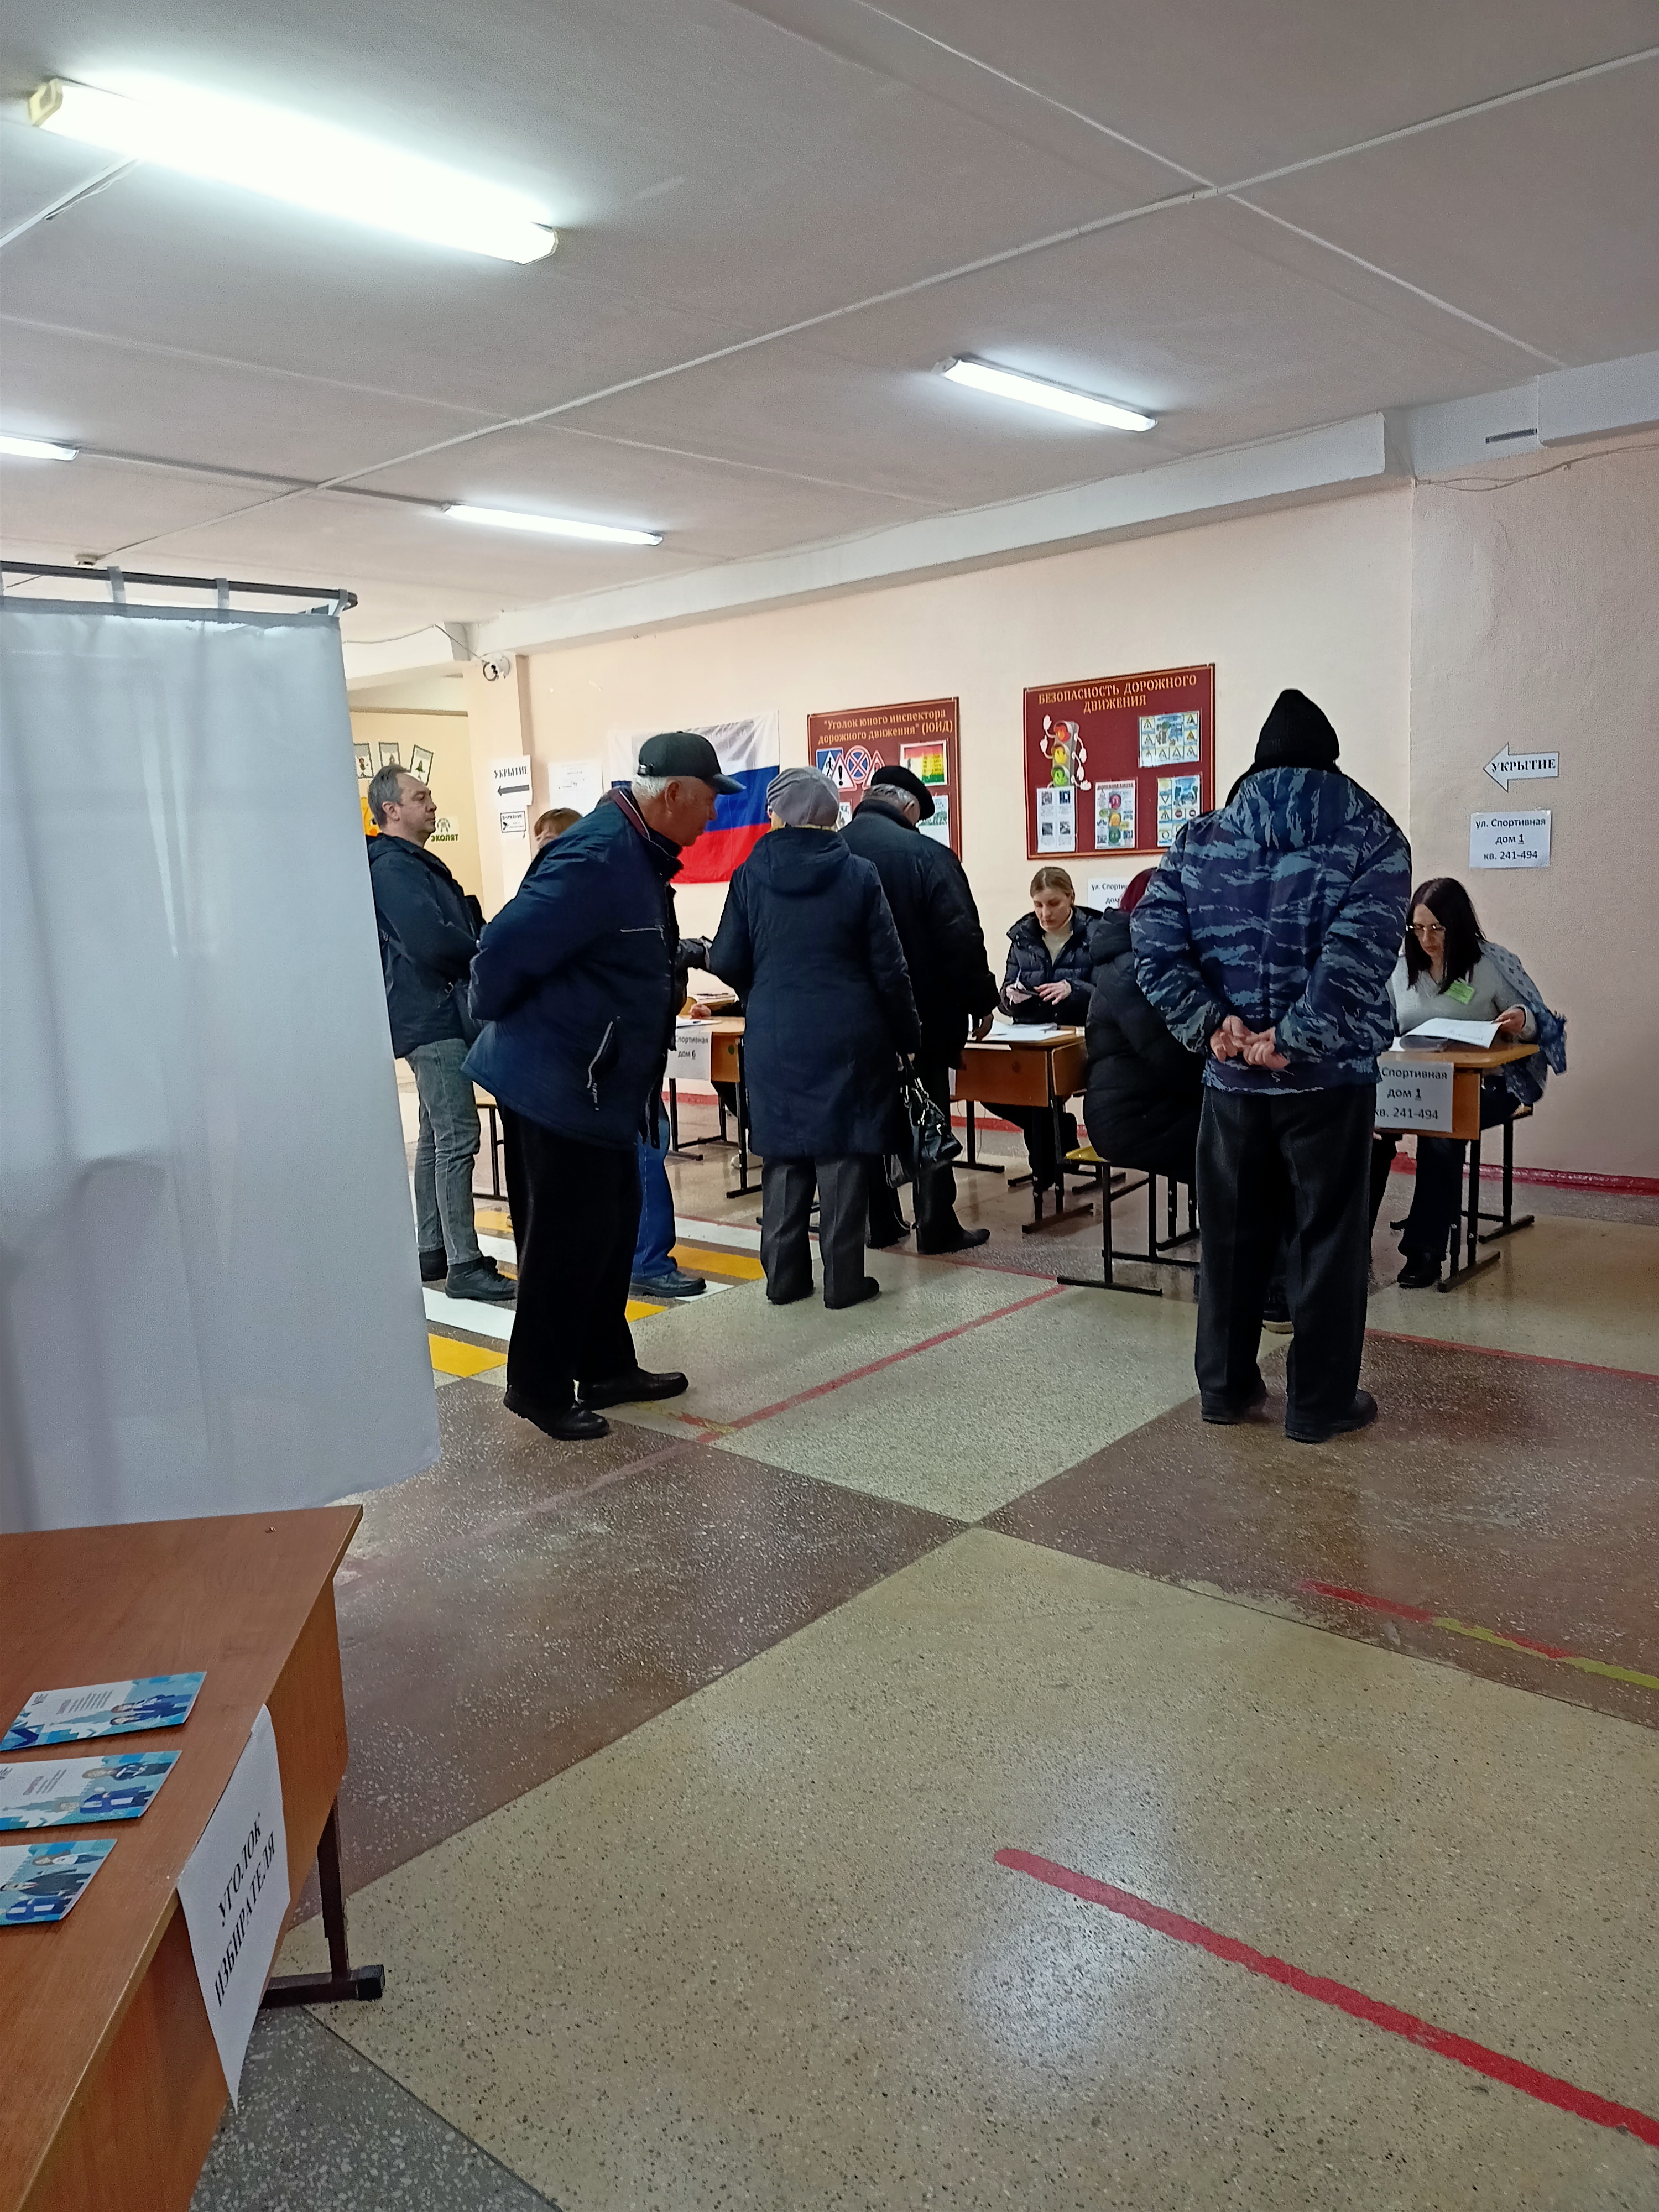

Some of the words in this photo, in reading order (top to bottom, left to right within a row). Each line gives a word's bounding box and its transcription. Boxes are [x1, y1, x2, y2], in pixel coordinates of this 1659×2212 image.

[1038, 684, 1120, 705] БЕЗОПАСНОСТЬ
[1124, 674, 1197, 696] ДОРОЖНОГО
[1083, 694, 1147, 714] ДВИЖЕНИЯ
[824, 719, 858, 731] "Уголок
[859, 716, 888, 727] юного
[889, 709, 946, 723] инспектора
[818, 732, 867, 745] дорожного
[868, 723, 919, 740] движения"
[1491, 759, 1556, 773] УКРЫТИЕ
[1475, 820, 1489, 829] ул.
[1491, 818, 1546, 828] Спортивная
[1495, 836, 1516, 845] дом
[1518, 833, 1525, 844] 1
[1499, 850, 1538, 860] 241-494
[692, 1049, 696, 1060] 6
[1381, 1067, 1447, 1079] Спортивная
[1387, 1088, 1411, 1099] дом
[1415, 1088, 1422, 1100] 1
[1393, 1107, 1438, 1120] 241-494
[218, 1812, 261, 1927] УГОЛОК
[215, 1831, 275, 2007] ИЗБИРАТЕЛЯ
